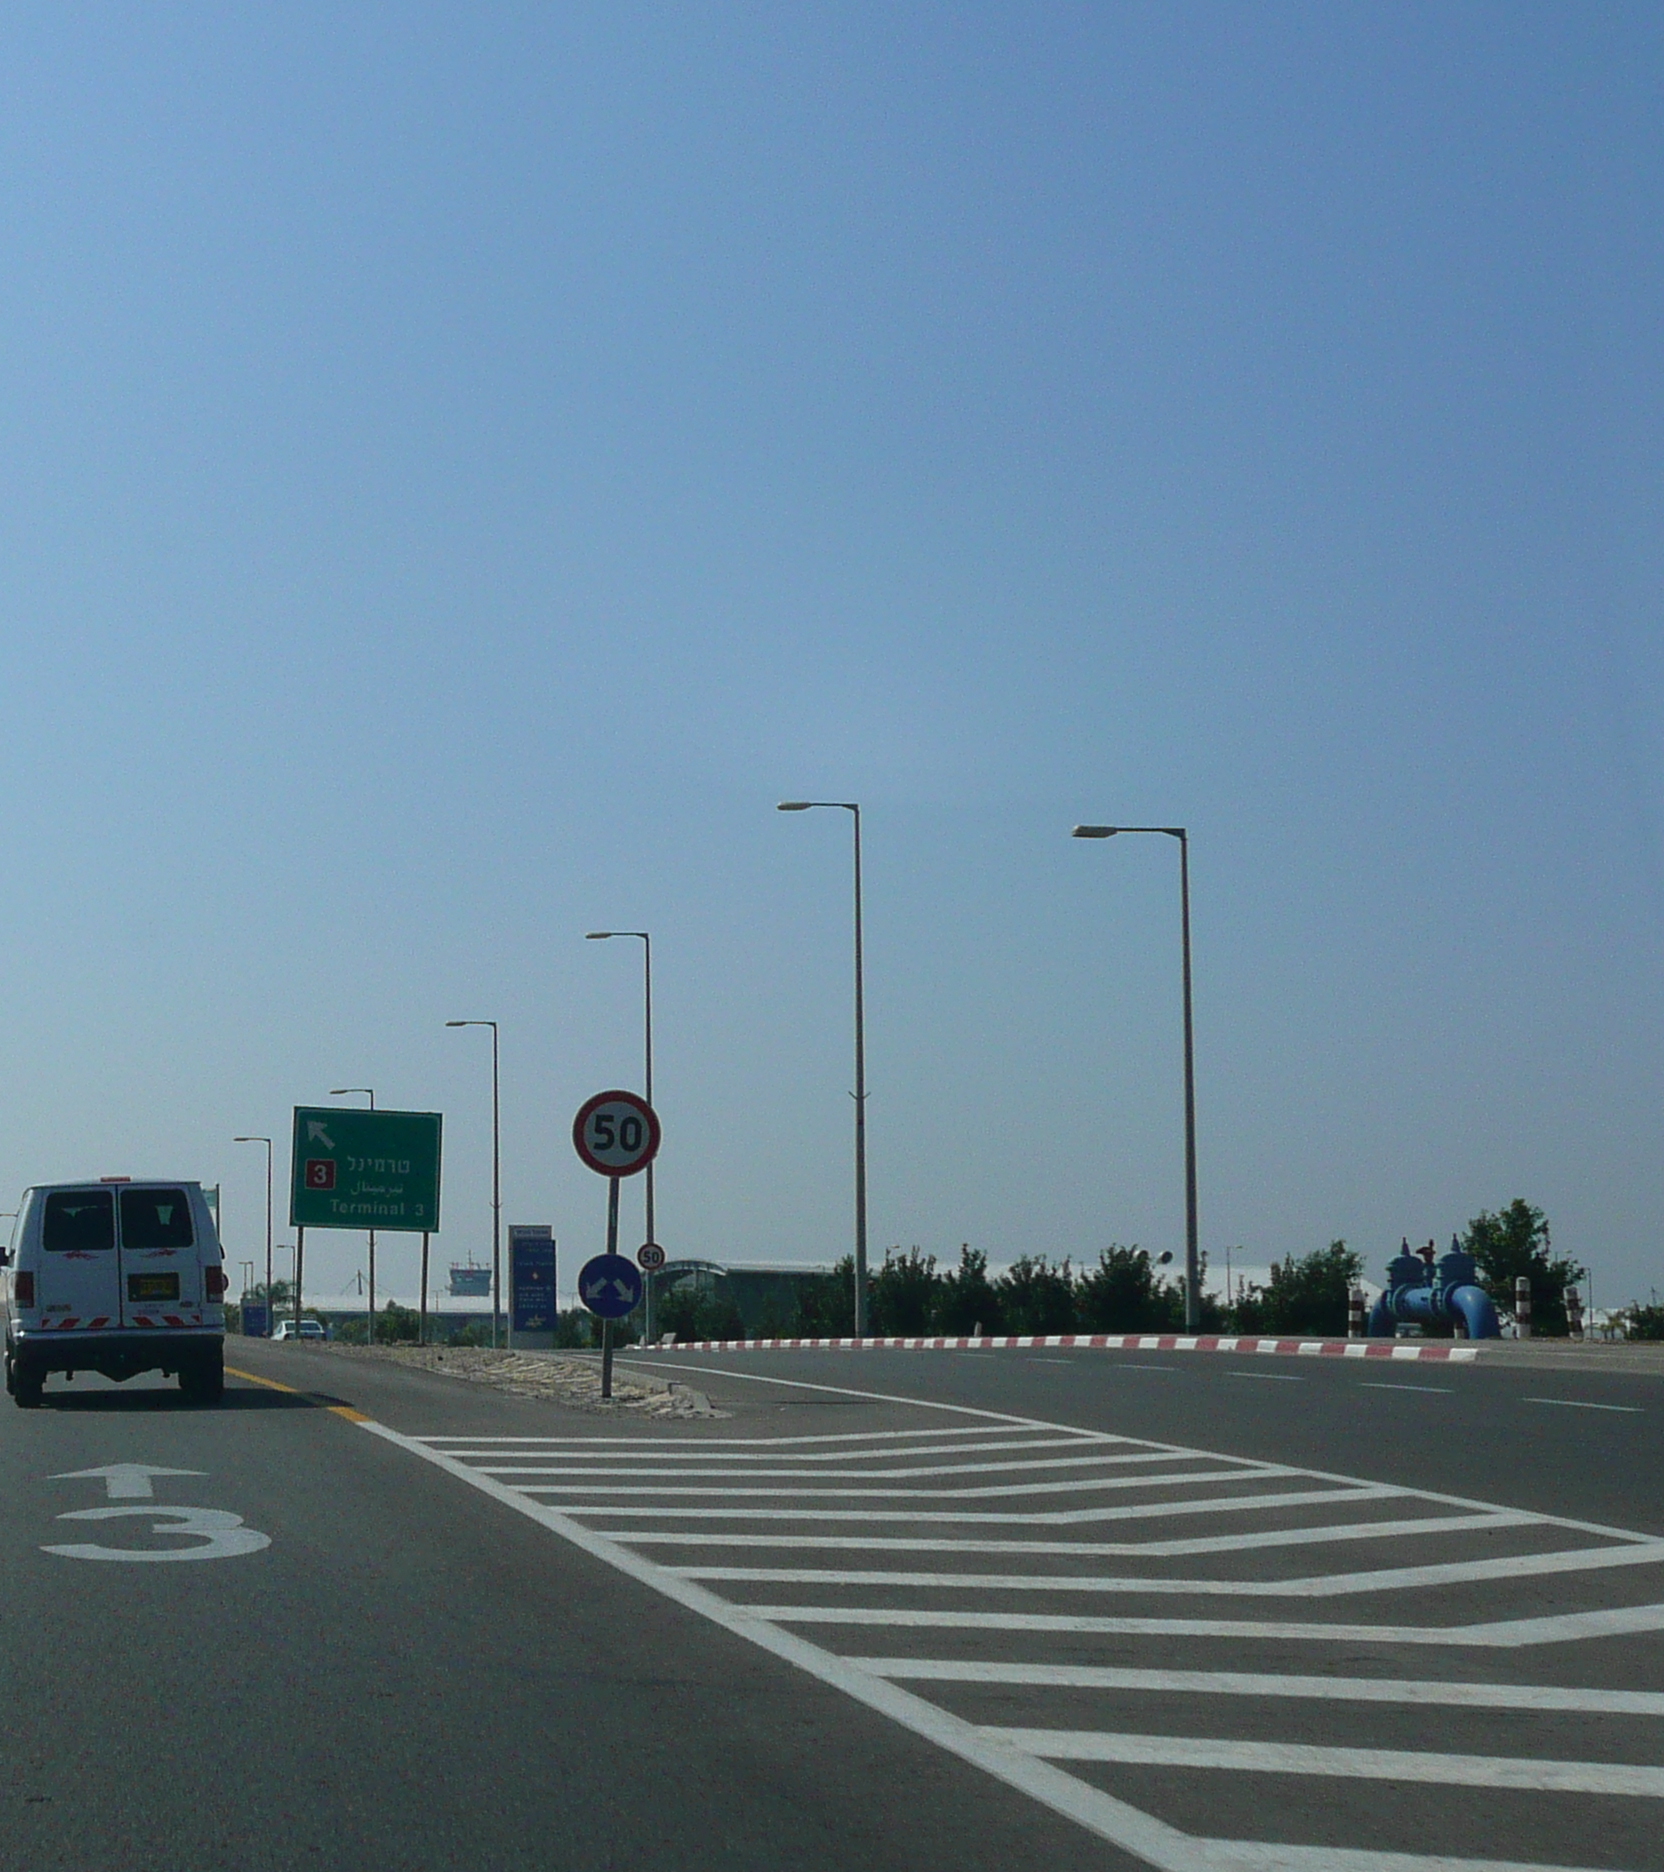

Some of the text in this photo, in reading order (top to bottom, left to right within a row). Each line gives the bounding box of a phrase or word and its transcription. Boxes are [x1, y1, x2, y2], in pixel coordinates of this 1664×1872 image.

[593, 1114, 643, 1153] 50
[313, 1164, 328, 1184] 3
[346, 1154, 411, 1174] טרמינל
[330, 1199, 425, 1217] Terminal 3
[642, 1250, 660, 1264] 50
[39, 1505, 272, 1562] 3
